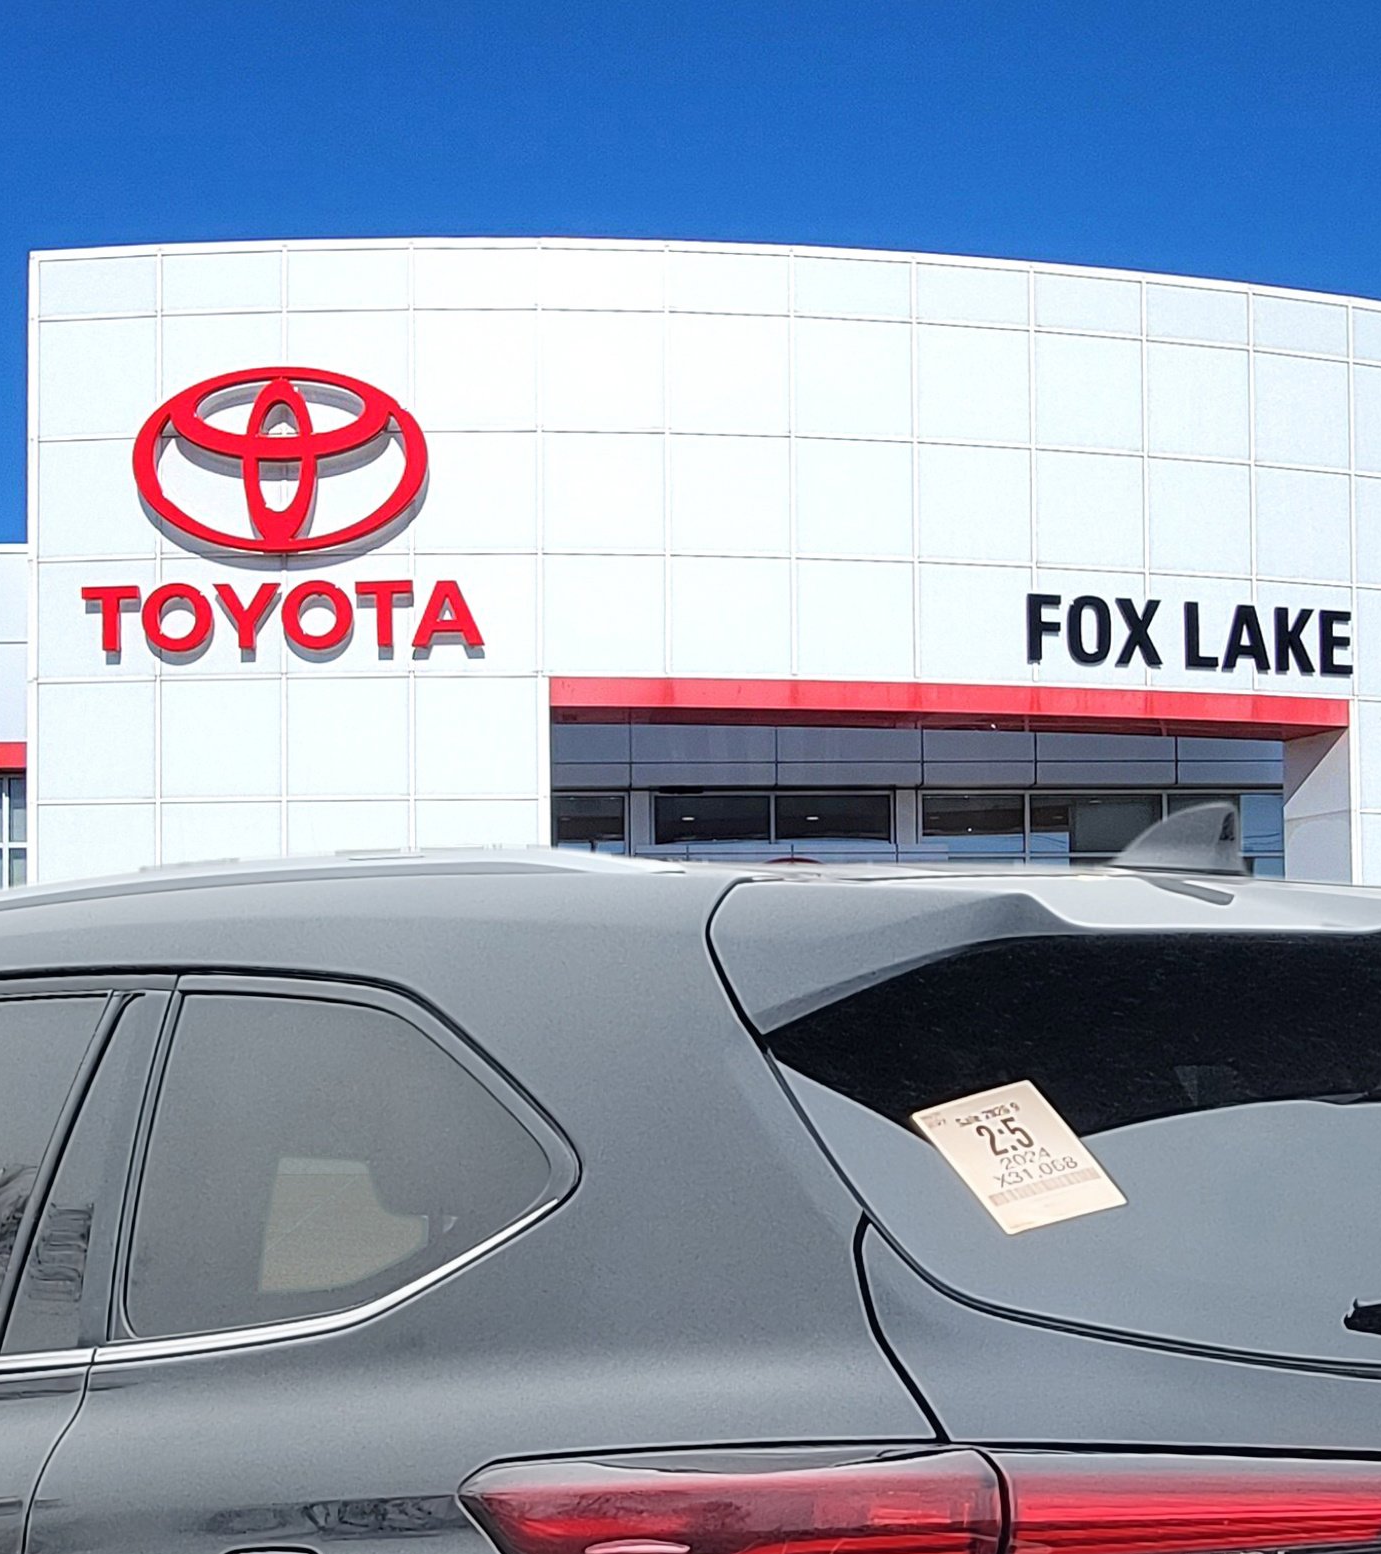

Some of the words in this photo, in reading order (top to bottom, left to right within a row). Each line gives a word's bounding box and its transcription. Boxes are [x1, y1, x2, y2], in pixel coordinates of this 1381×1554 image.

[81, 579, 485, 655] TOYOTA
[1026, 593, 1163, 668] FOX
[1183, 601, 1354, 676] LAKE
